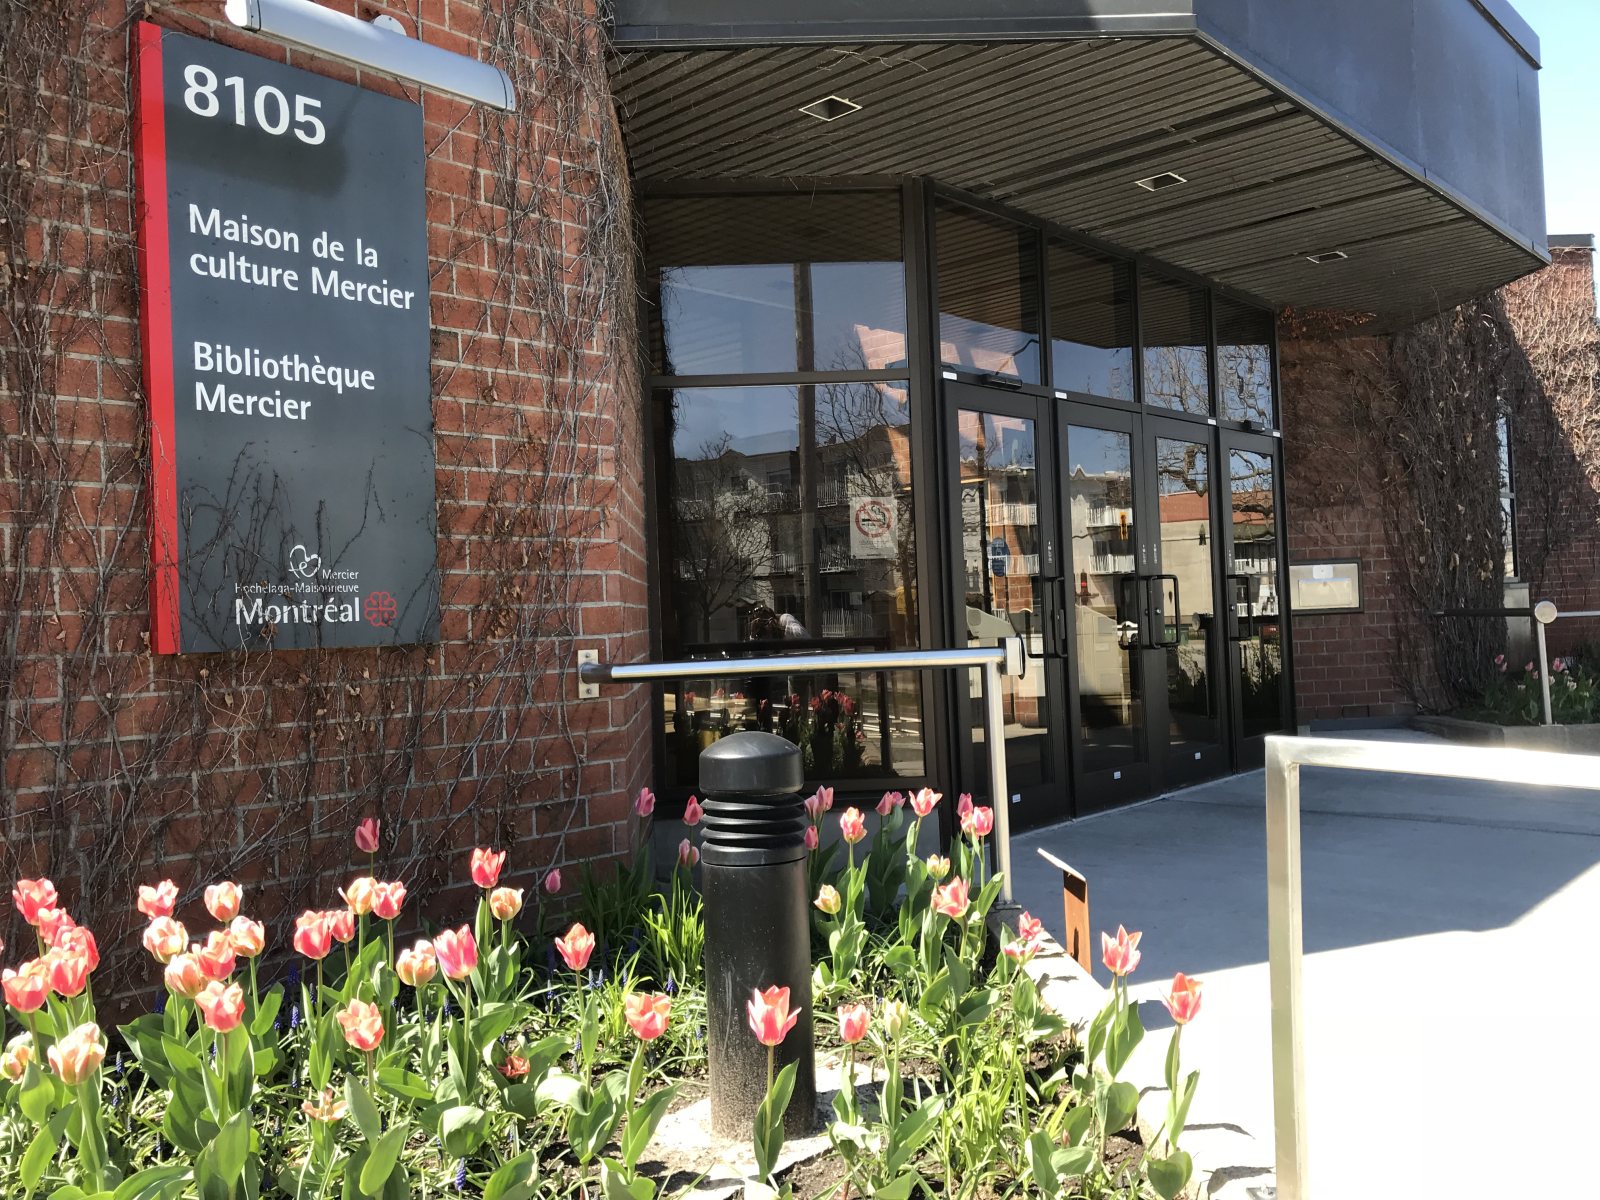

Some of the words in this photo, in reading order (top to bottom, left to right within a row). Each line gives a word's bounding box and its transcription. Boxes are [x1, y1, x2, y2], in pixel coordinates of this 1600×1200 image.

[183, 64, 326, 145] 8105
[189, 203, 300, 253] Maison
[312, 231, 345, 262] de
[356, 238, 378, 268] la
[189, 251, 299, 291] culture
[311, 267, 415, 310] Mercier
[193, 341, 375, 394] Bibliothèque
[195, 381, 312, 421] Mercier
[322, 569, 359, 580] Mercier
[235, 597, 360, 625] Montréal
